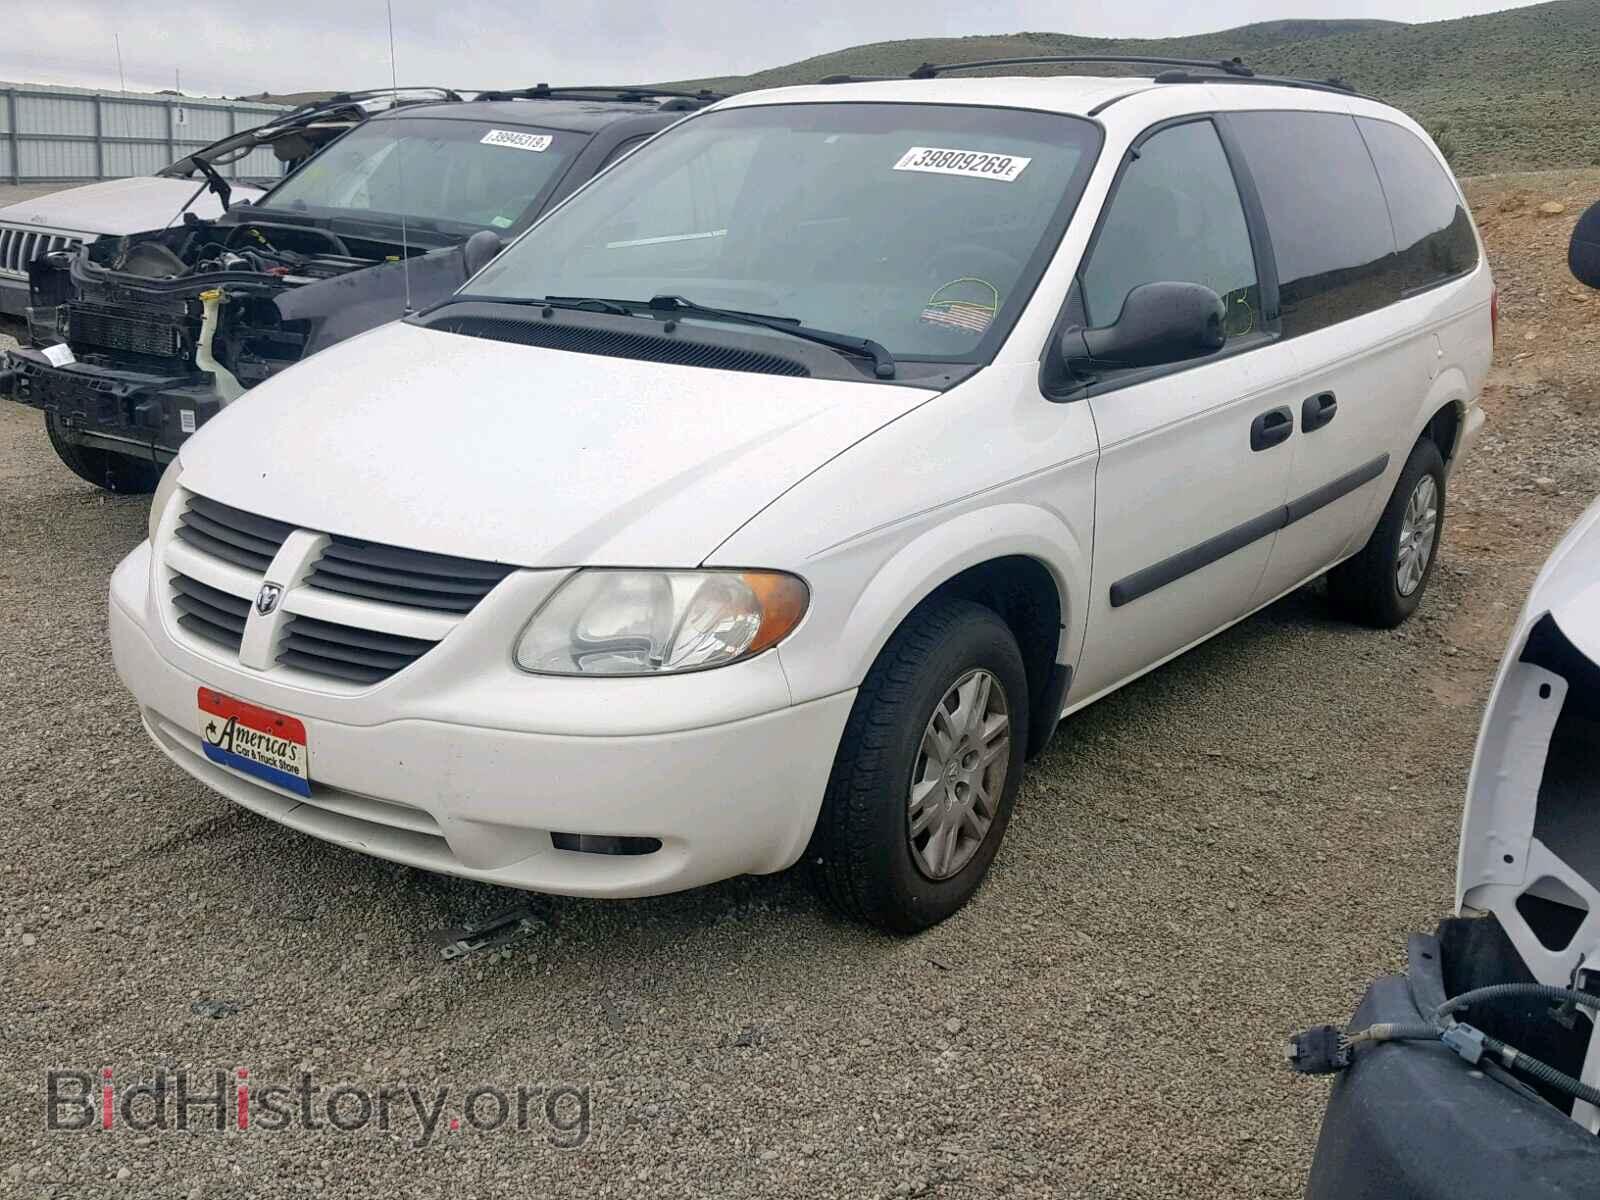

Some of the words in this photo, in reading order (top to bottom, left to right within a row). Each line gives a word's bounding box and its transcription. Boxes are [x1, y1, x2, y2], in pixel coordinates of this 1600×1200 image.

[206, 716, 297, 760] America's
[236, 744, 250, 757] Car
[259, 752, 277, 767] Truck
[279, 760, 300, 775] Store
